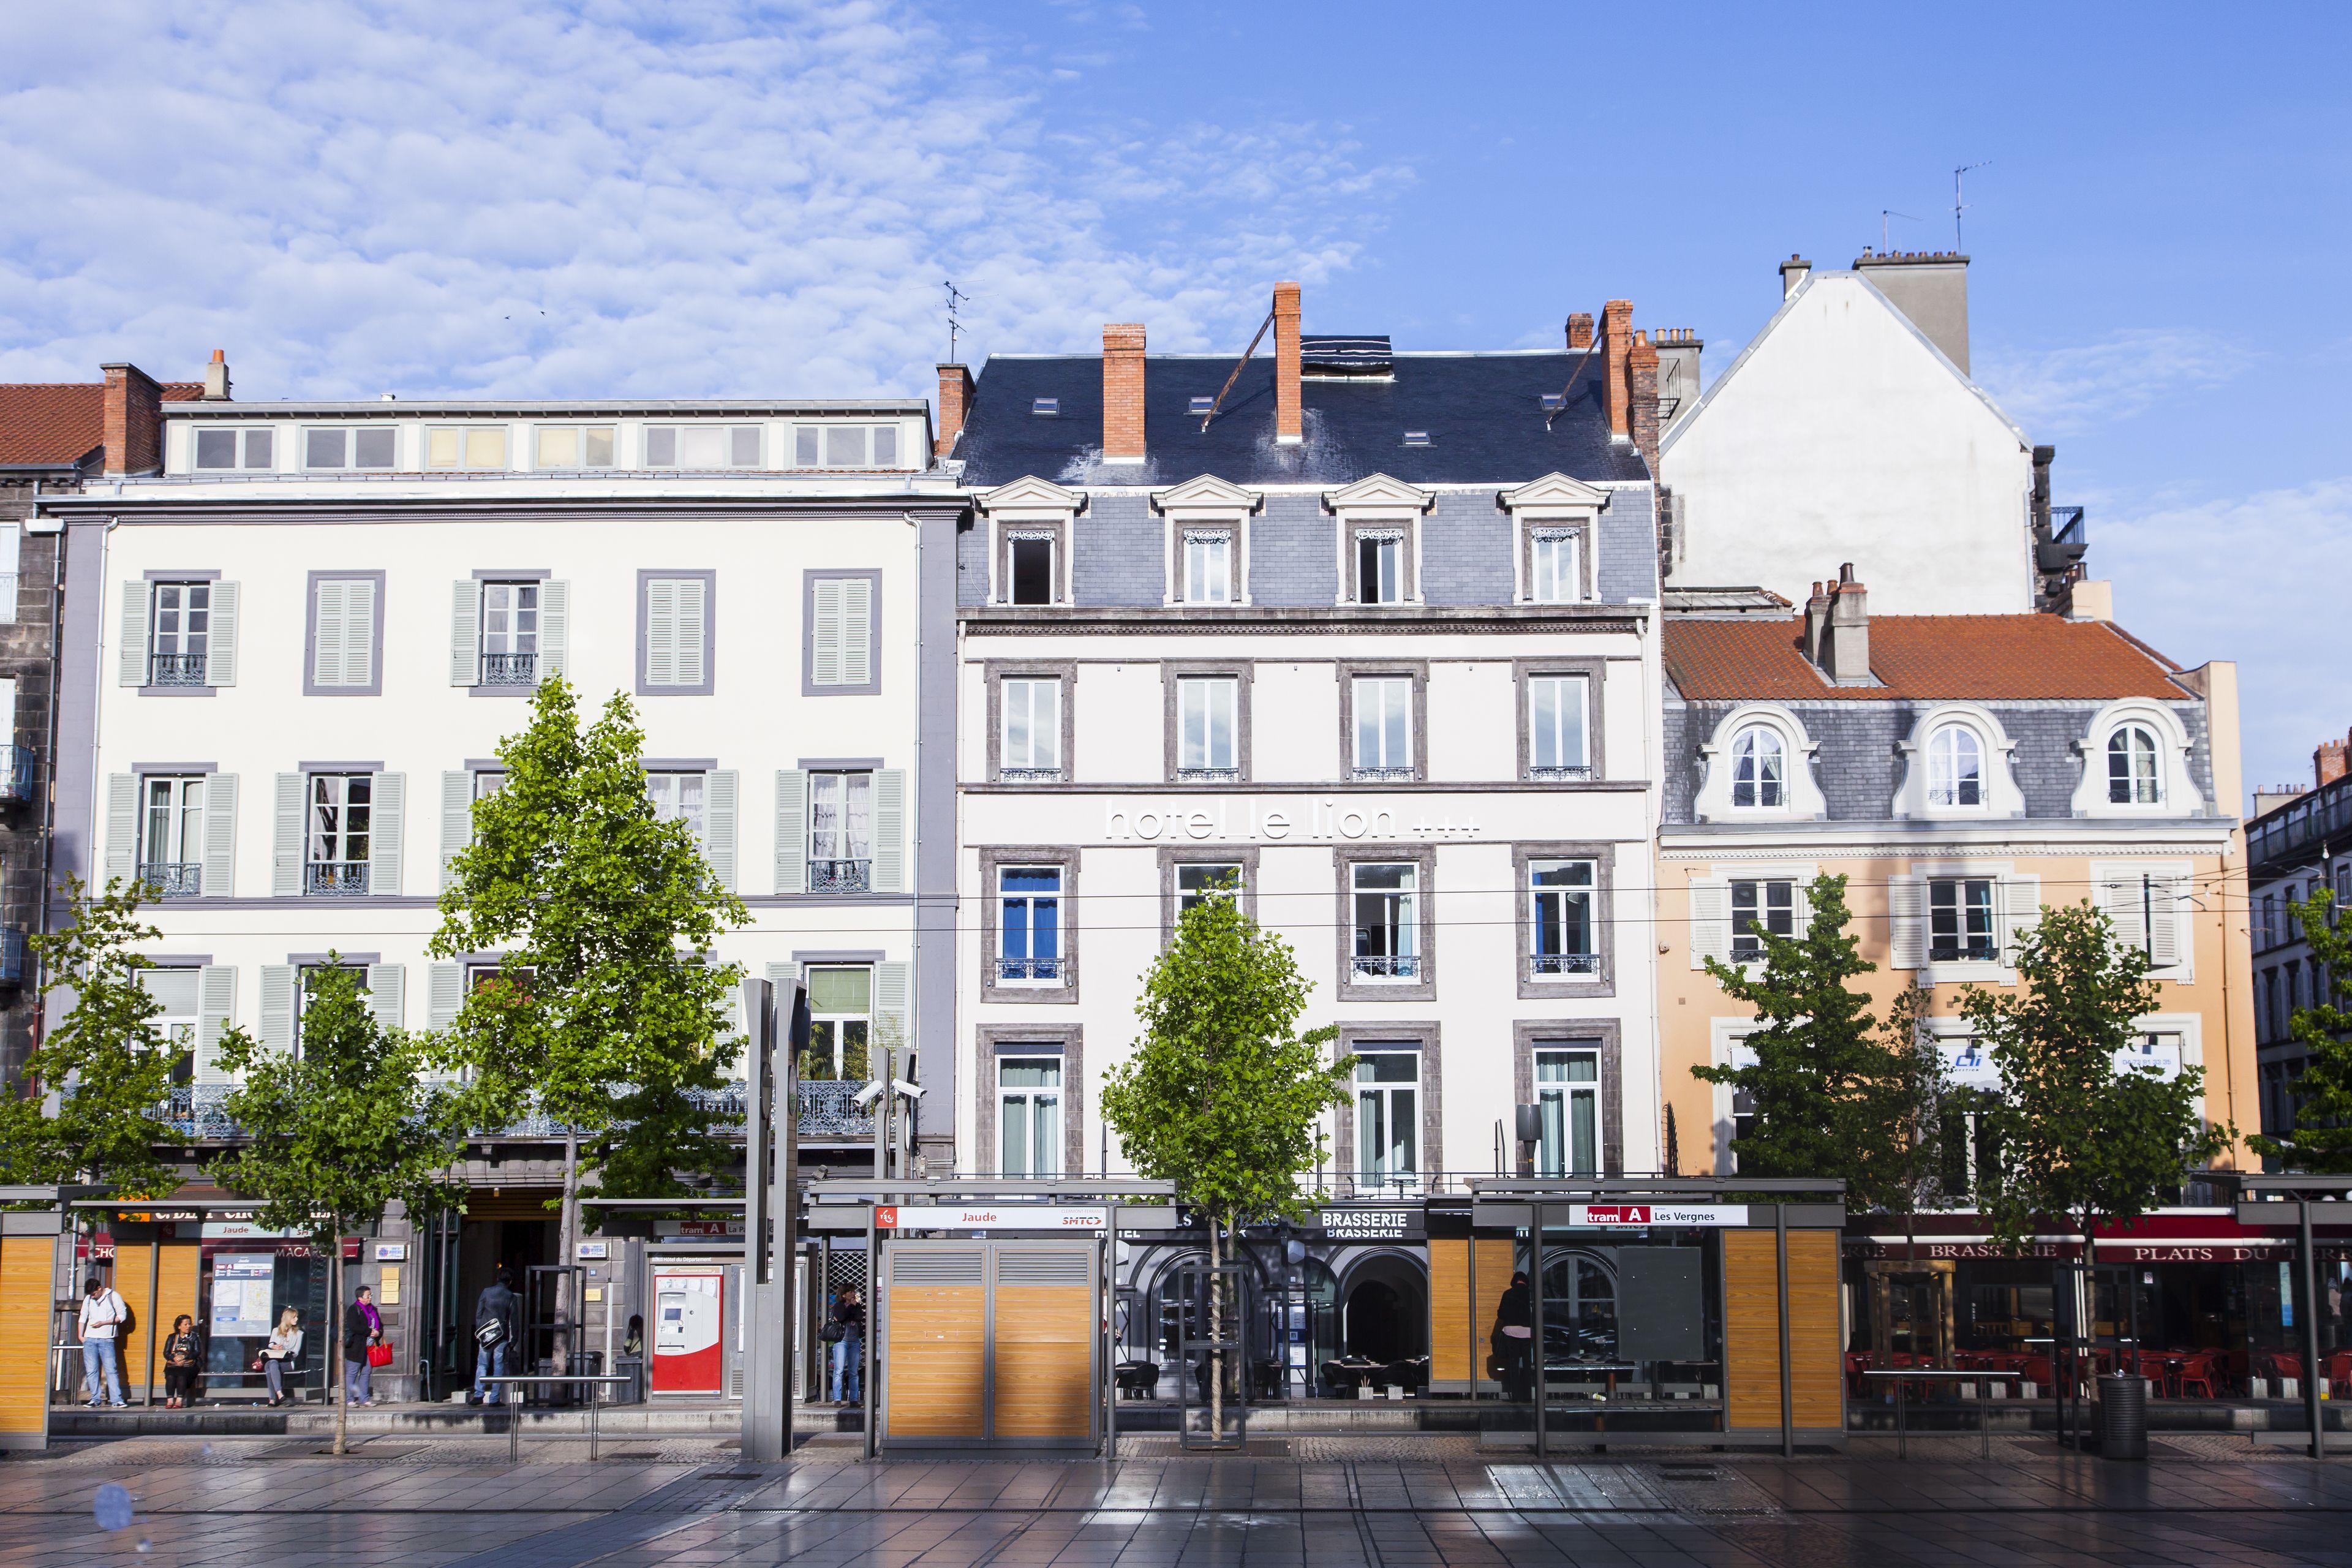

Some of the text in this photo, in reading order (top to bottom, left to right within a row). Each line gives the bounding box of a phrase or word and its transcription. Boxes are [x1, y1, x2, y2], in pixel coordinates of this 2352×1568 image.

[1106, 798, 1226, 840] hotel
[1250, 798, 1290, 840] le
[1313, 797, 1396, 840] lion
[962, 1212, 997, 1222] Jaude
[1322, 1213, 1407, 1227] BRASSERIE
[1588, 1208, 1642, 1222] tram A
[1654, 1212, 1715, 1223] Les Vergnes
[710, 1224, 720, 1233] A
[1327, 1229, 1403, 1238] BRASSERIE
[2135, 1248, 2214, 1261] PLATS
[2234, 1248, 2269, 1261] DU
